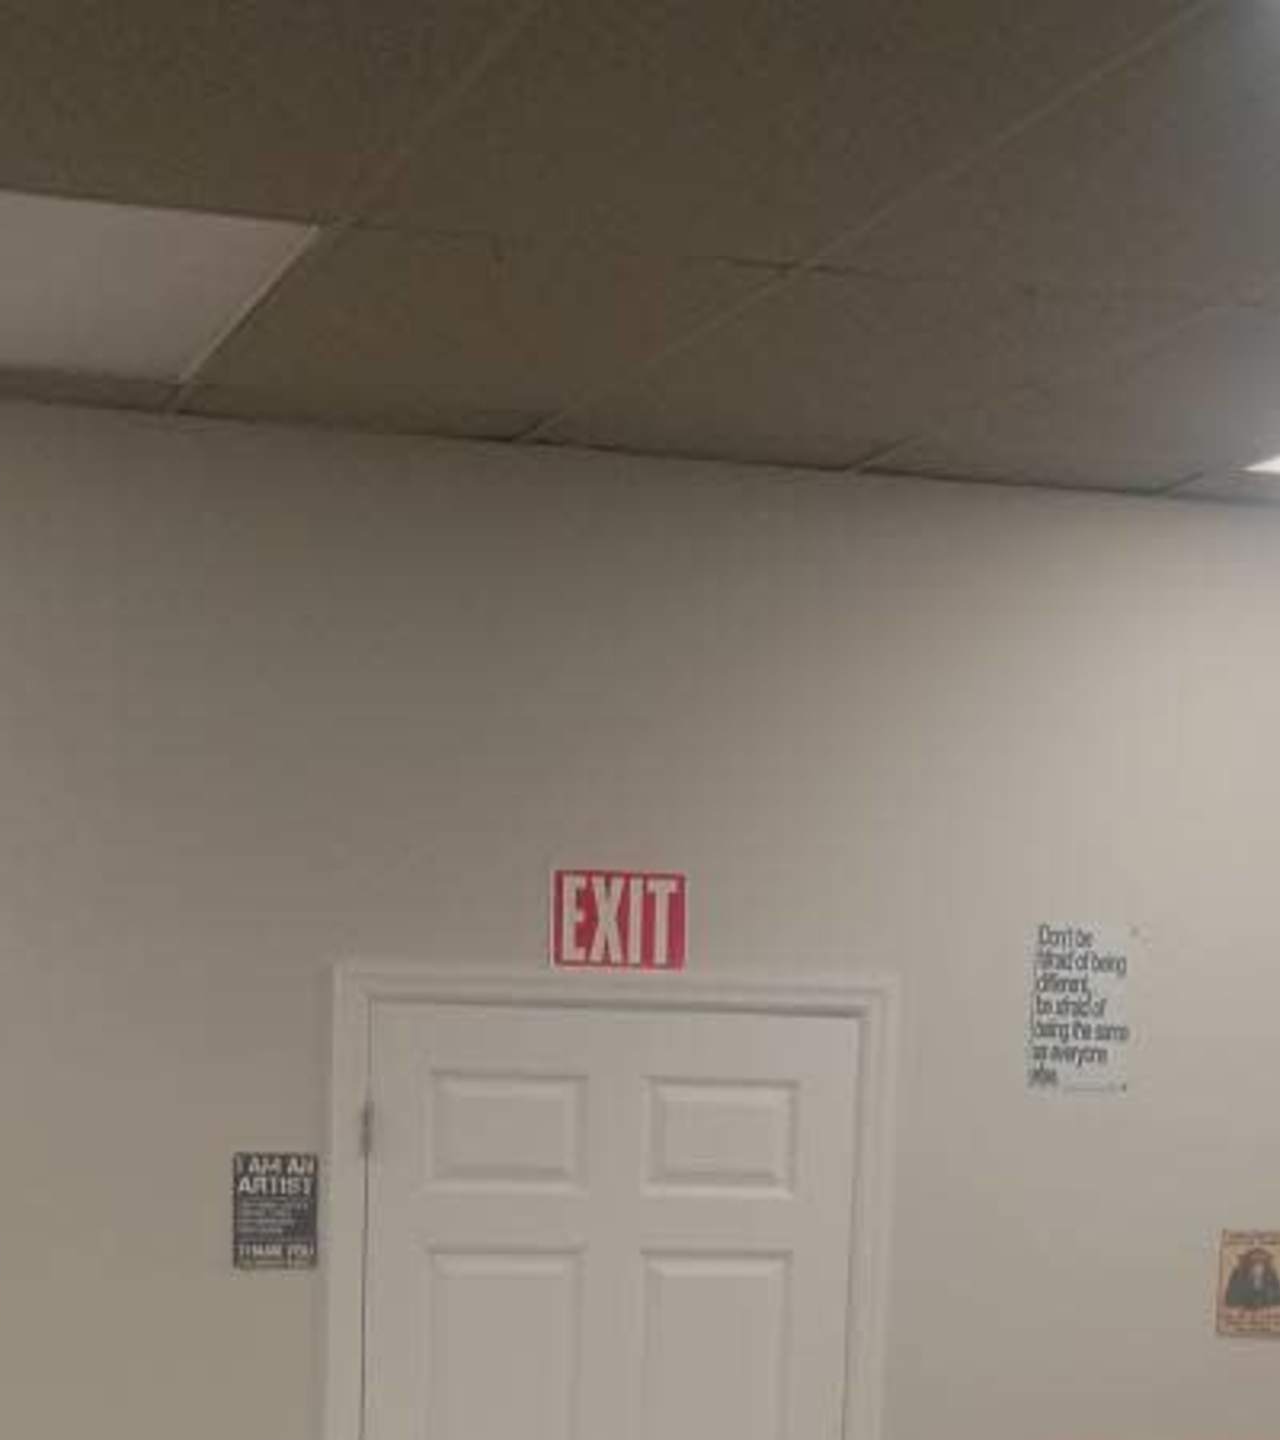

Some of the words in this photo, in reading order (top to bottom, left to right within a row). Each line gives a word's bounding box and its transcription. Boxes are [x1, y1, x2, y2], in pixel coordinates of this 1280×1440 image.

[562, 874, 677, 965] EXIT
[1075, 951, 1088, 971] of
[1091, 952, 1128, 978] being
[1034, 1021, 1070, 1043] being
[1073, 1021, 1092, 1041] the
[249, 1156, 281, 1174] AM
[287, 1156, 315, 1175] AN
[238, 1176, 314, 1195] ARTIST
